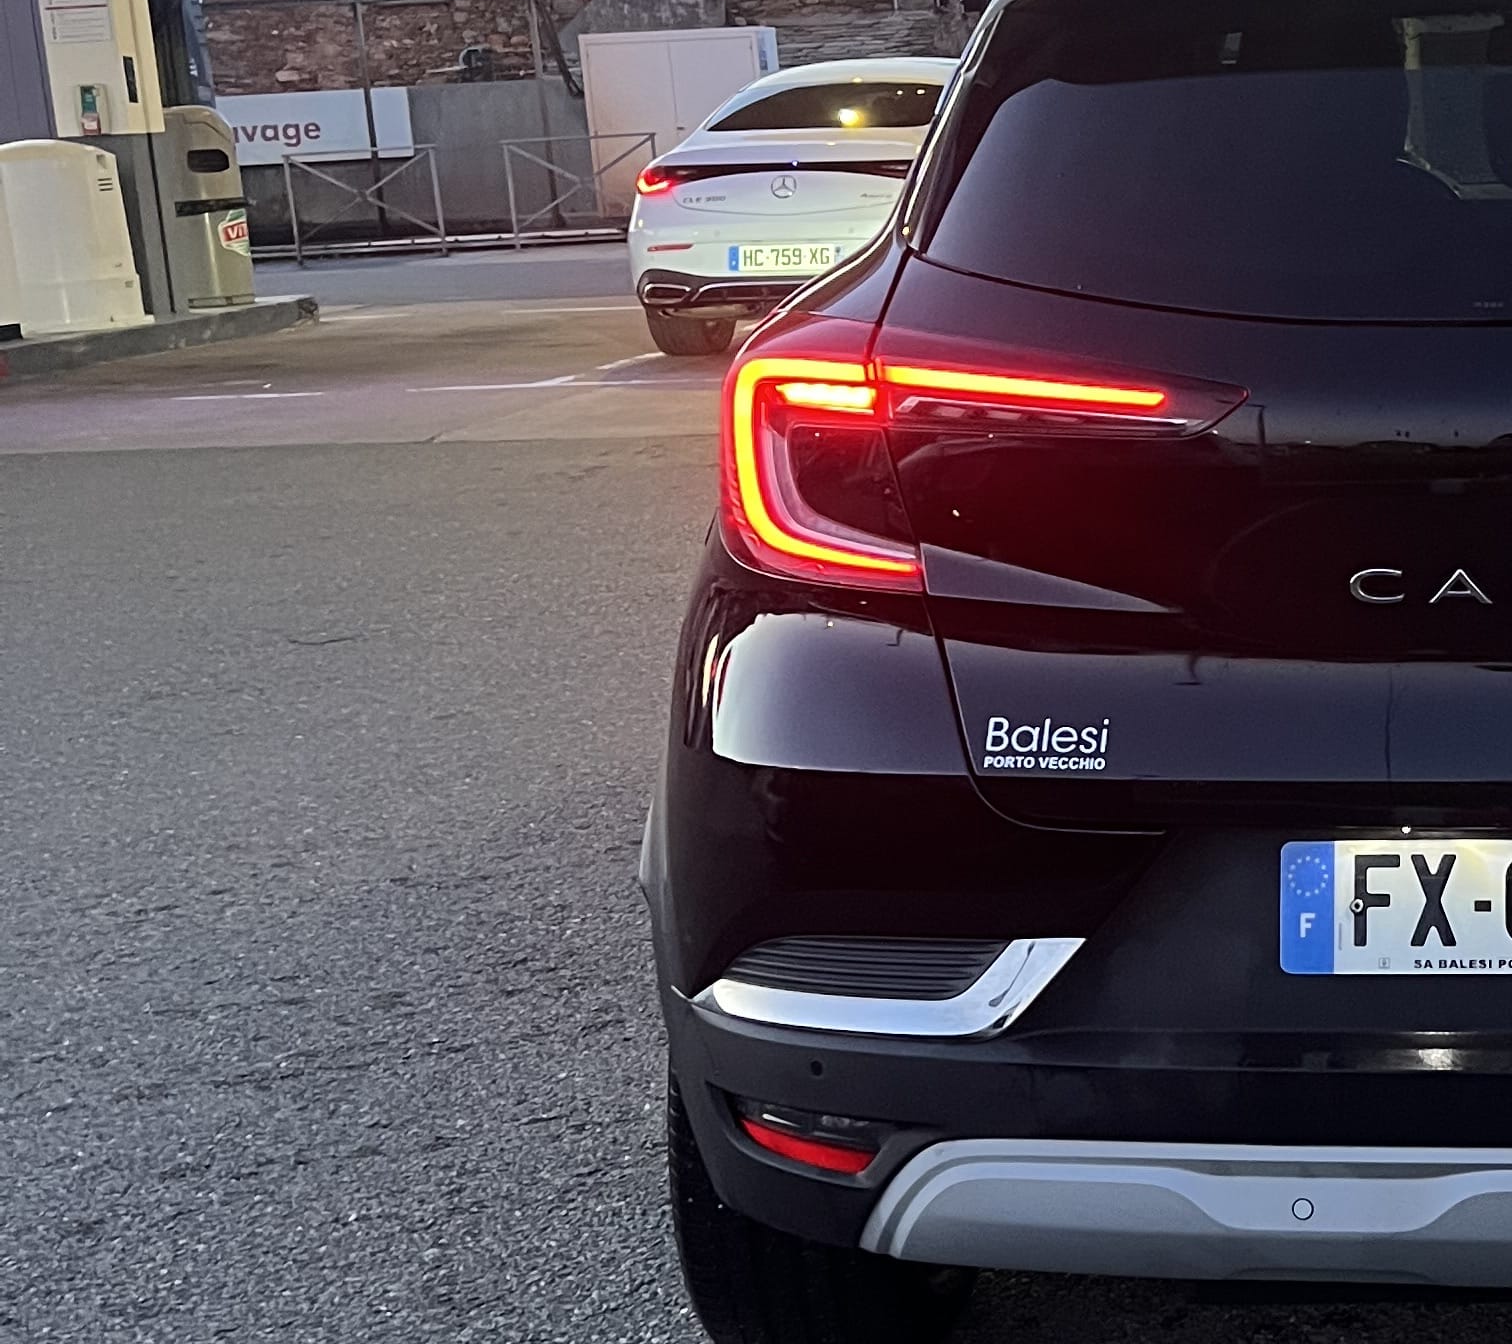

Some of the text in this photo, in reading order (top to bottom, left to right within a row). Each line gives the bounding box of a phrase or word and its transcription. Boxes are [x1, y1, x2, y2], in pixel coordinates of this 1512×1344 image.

[985, 716, 1110, 753] Balesi
[983, 755, 1106, 770] PORTO VECCHIO
[1299, 912, 1316, 938] F
[1413, 959, 1433, 969] SA
[1438, 959, 1493, 969] BALESI
